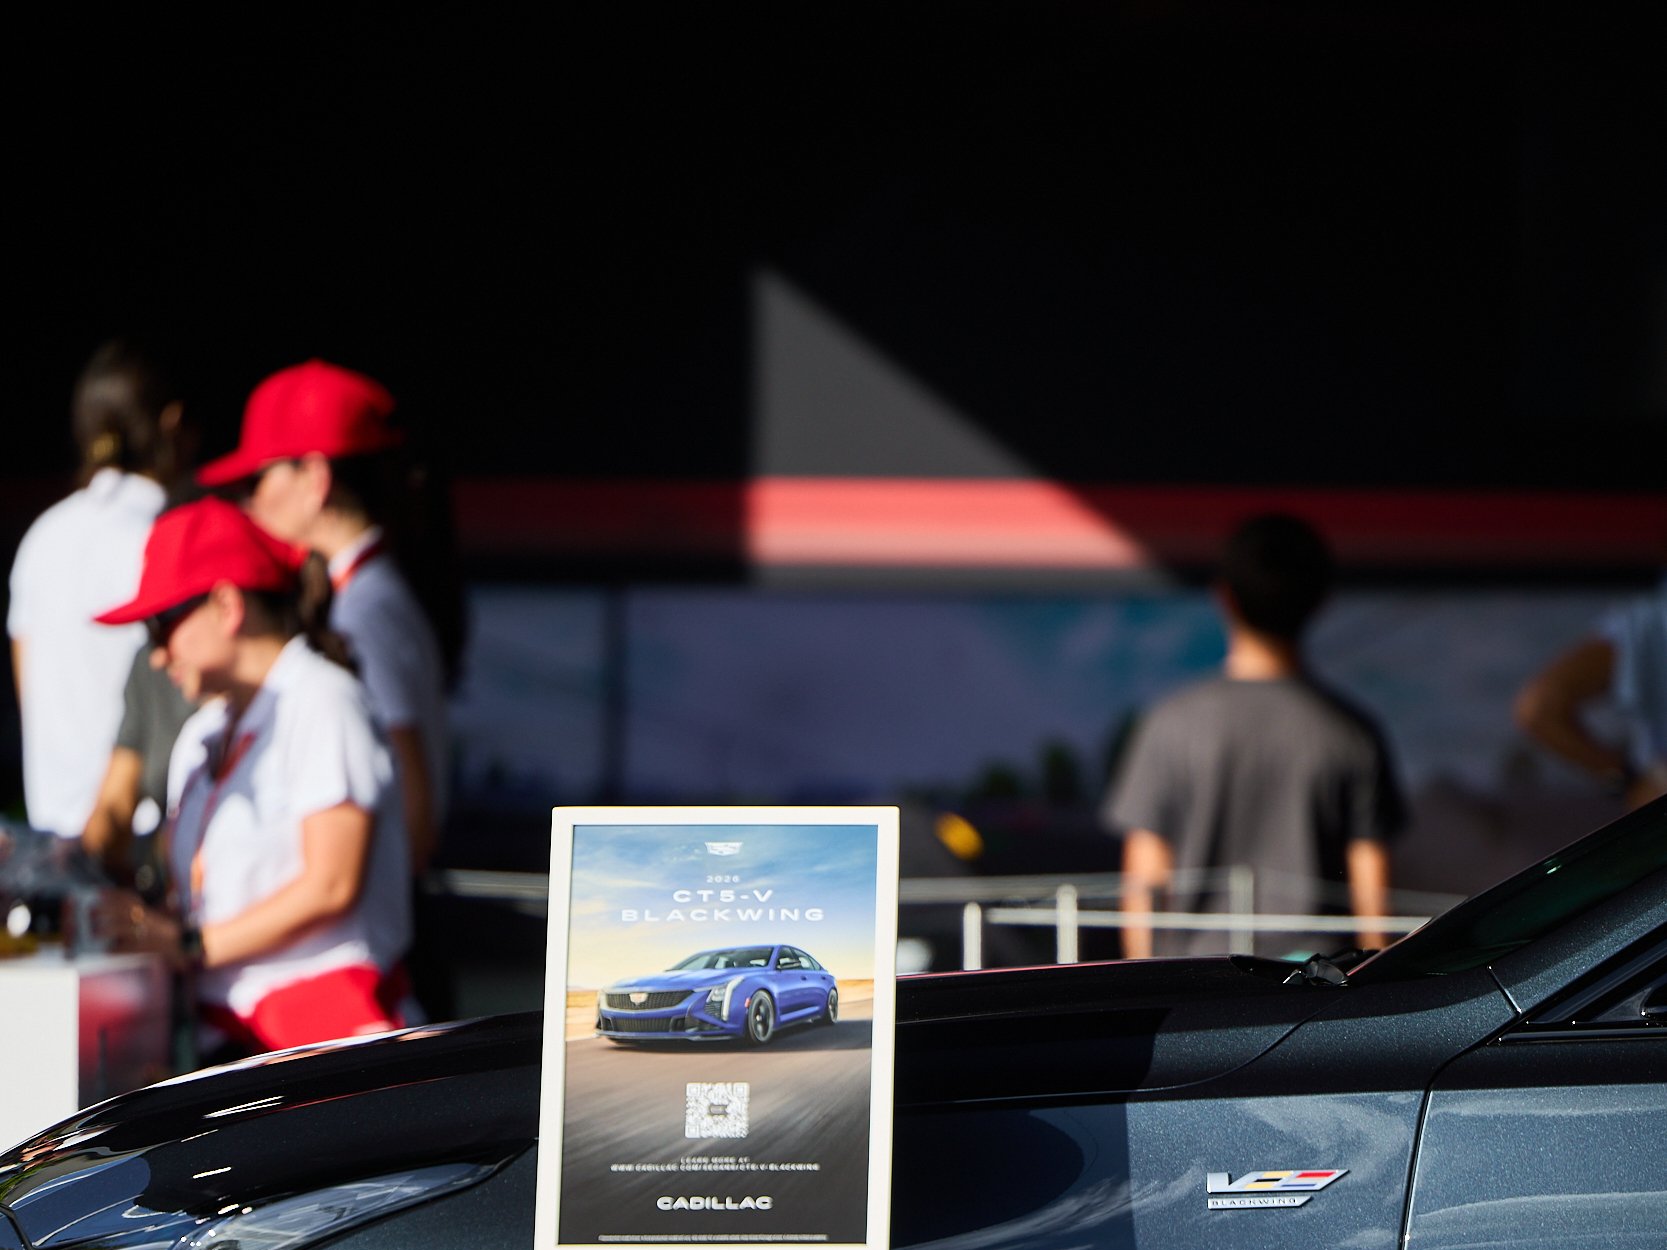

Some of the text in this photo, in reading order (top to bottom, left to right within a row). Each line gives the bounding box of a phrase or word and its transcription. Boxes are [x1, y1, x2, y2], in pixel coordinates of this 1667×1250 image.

[706, 874, 741, 883] 2026
[672, 889, 774, 903] CT5-V
[620, 908, 825, 922] BLACKWING
[656, 1196, 773, 1210] CADILLAC
